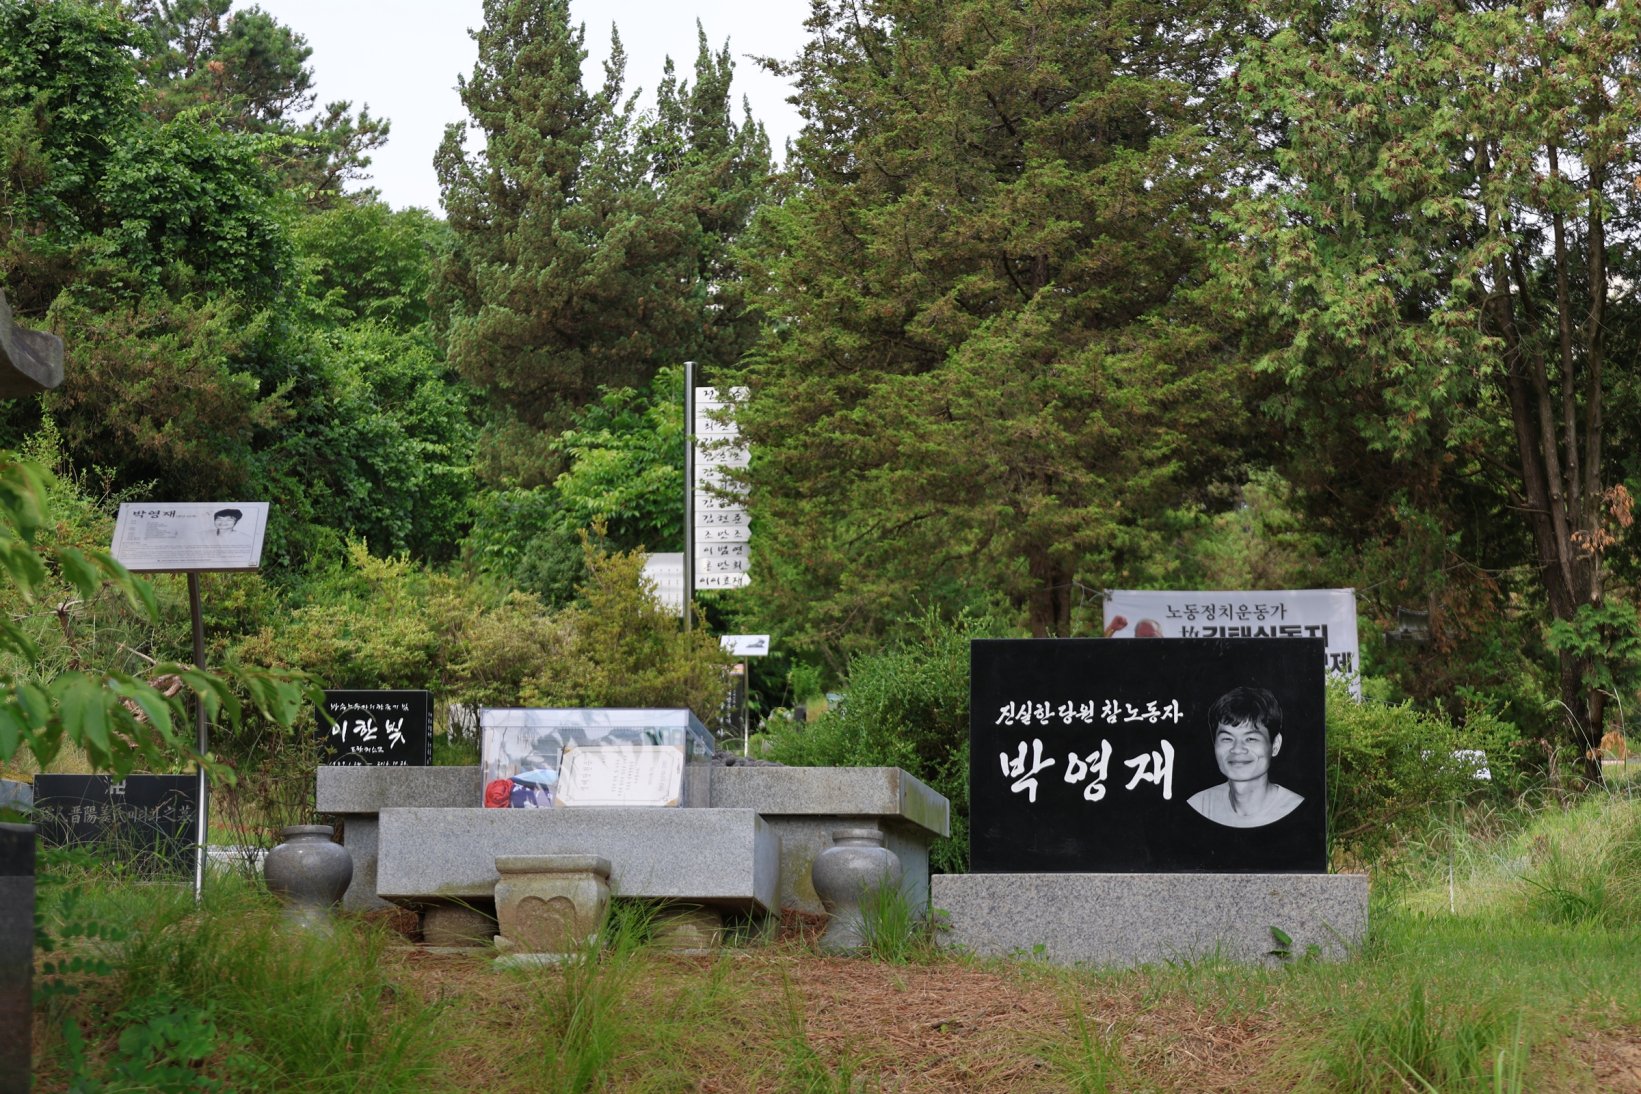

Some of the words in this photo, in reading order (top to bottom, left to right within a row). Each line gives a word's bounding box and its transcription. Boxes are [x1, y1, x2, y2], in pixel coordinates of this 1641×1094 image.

[133, 509, 176, 519] 박영재
[1166, 603, 1287, 621] 노동정치운동가
[996, 701, 1055, 725] 진실한
[1057, 700, 1095, 725] 당원
[331, 717, 406, 749] 이한빛
[999, 738, 1176, 803] 박영재
